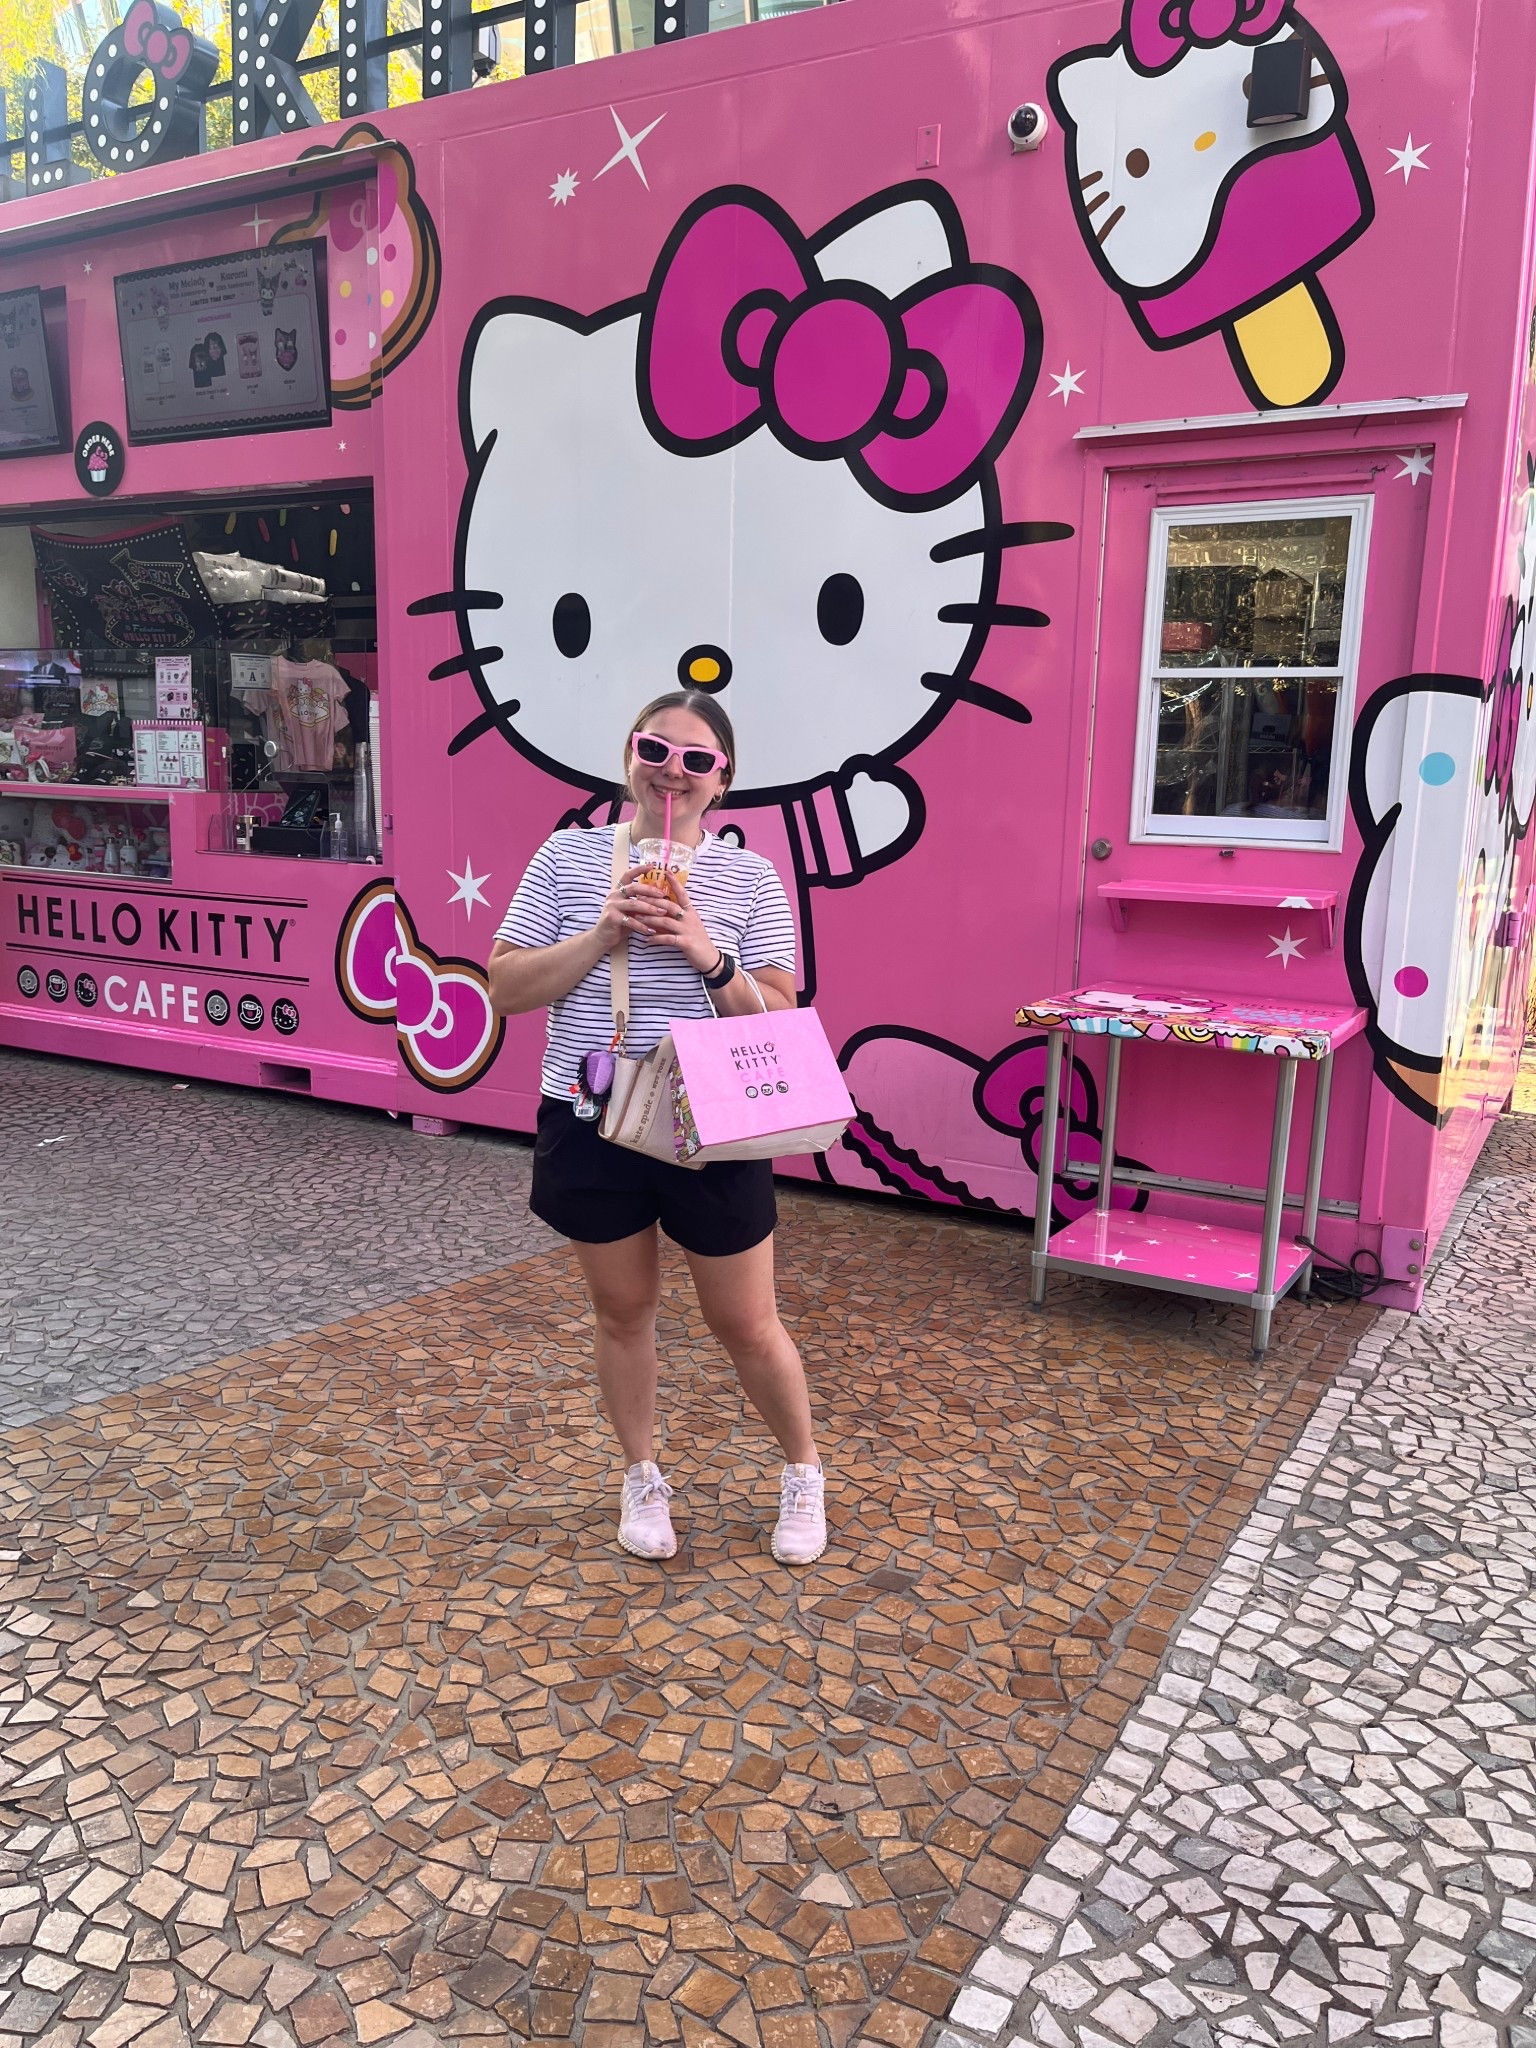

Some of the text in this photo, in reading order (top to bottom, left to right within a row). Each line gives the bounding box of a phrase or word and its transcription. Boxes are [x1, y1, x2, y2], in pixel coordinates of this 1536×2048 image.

[180, 276, 206, 288] Melody
[220, 268, 249, 281] Kuromi
[82, 434, 115, 458] ORDER HERE
[248, 671, 257, 682] A
[643, 871, 668, 881] KITT
[17, 893, 142, 946] HELLO
[104, 975, 199, 1024] CAFE
[730, 1041, 775, 1058] HELLO
[735, 1055, 778, 1071] KITTY
[740, 1067, 785, 1083] CAFE
[630, 1125, 645, 1144] kate
[640, 1099, 653, 1124] spade
